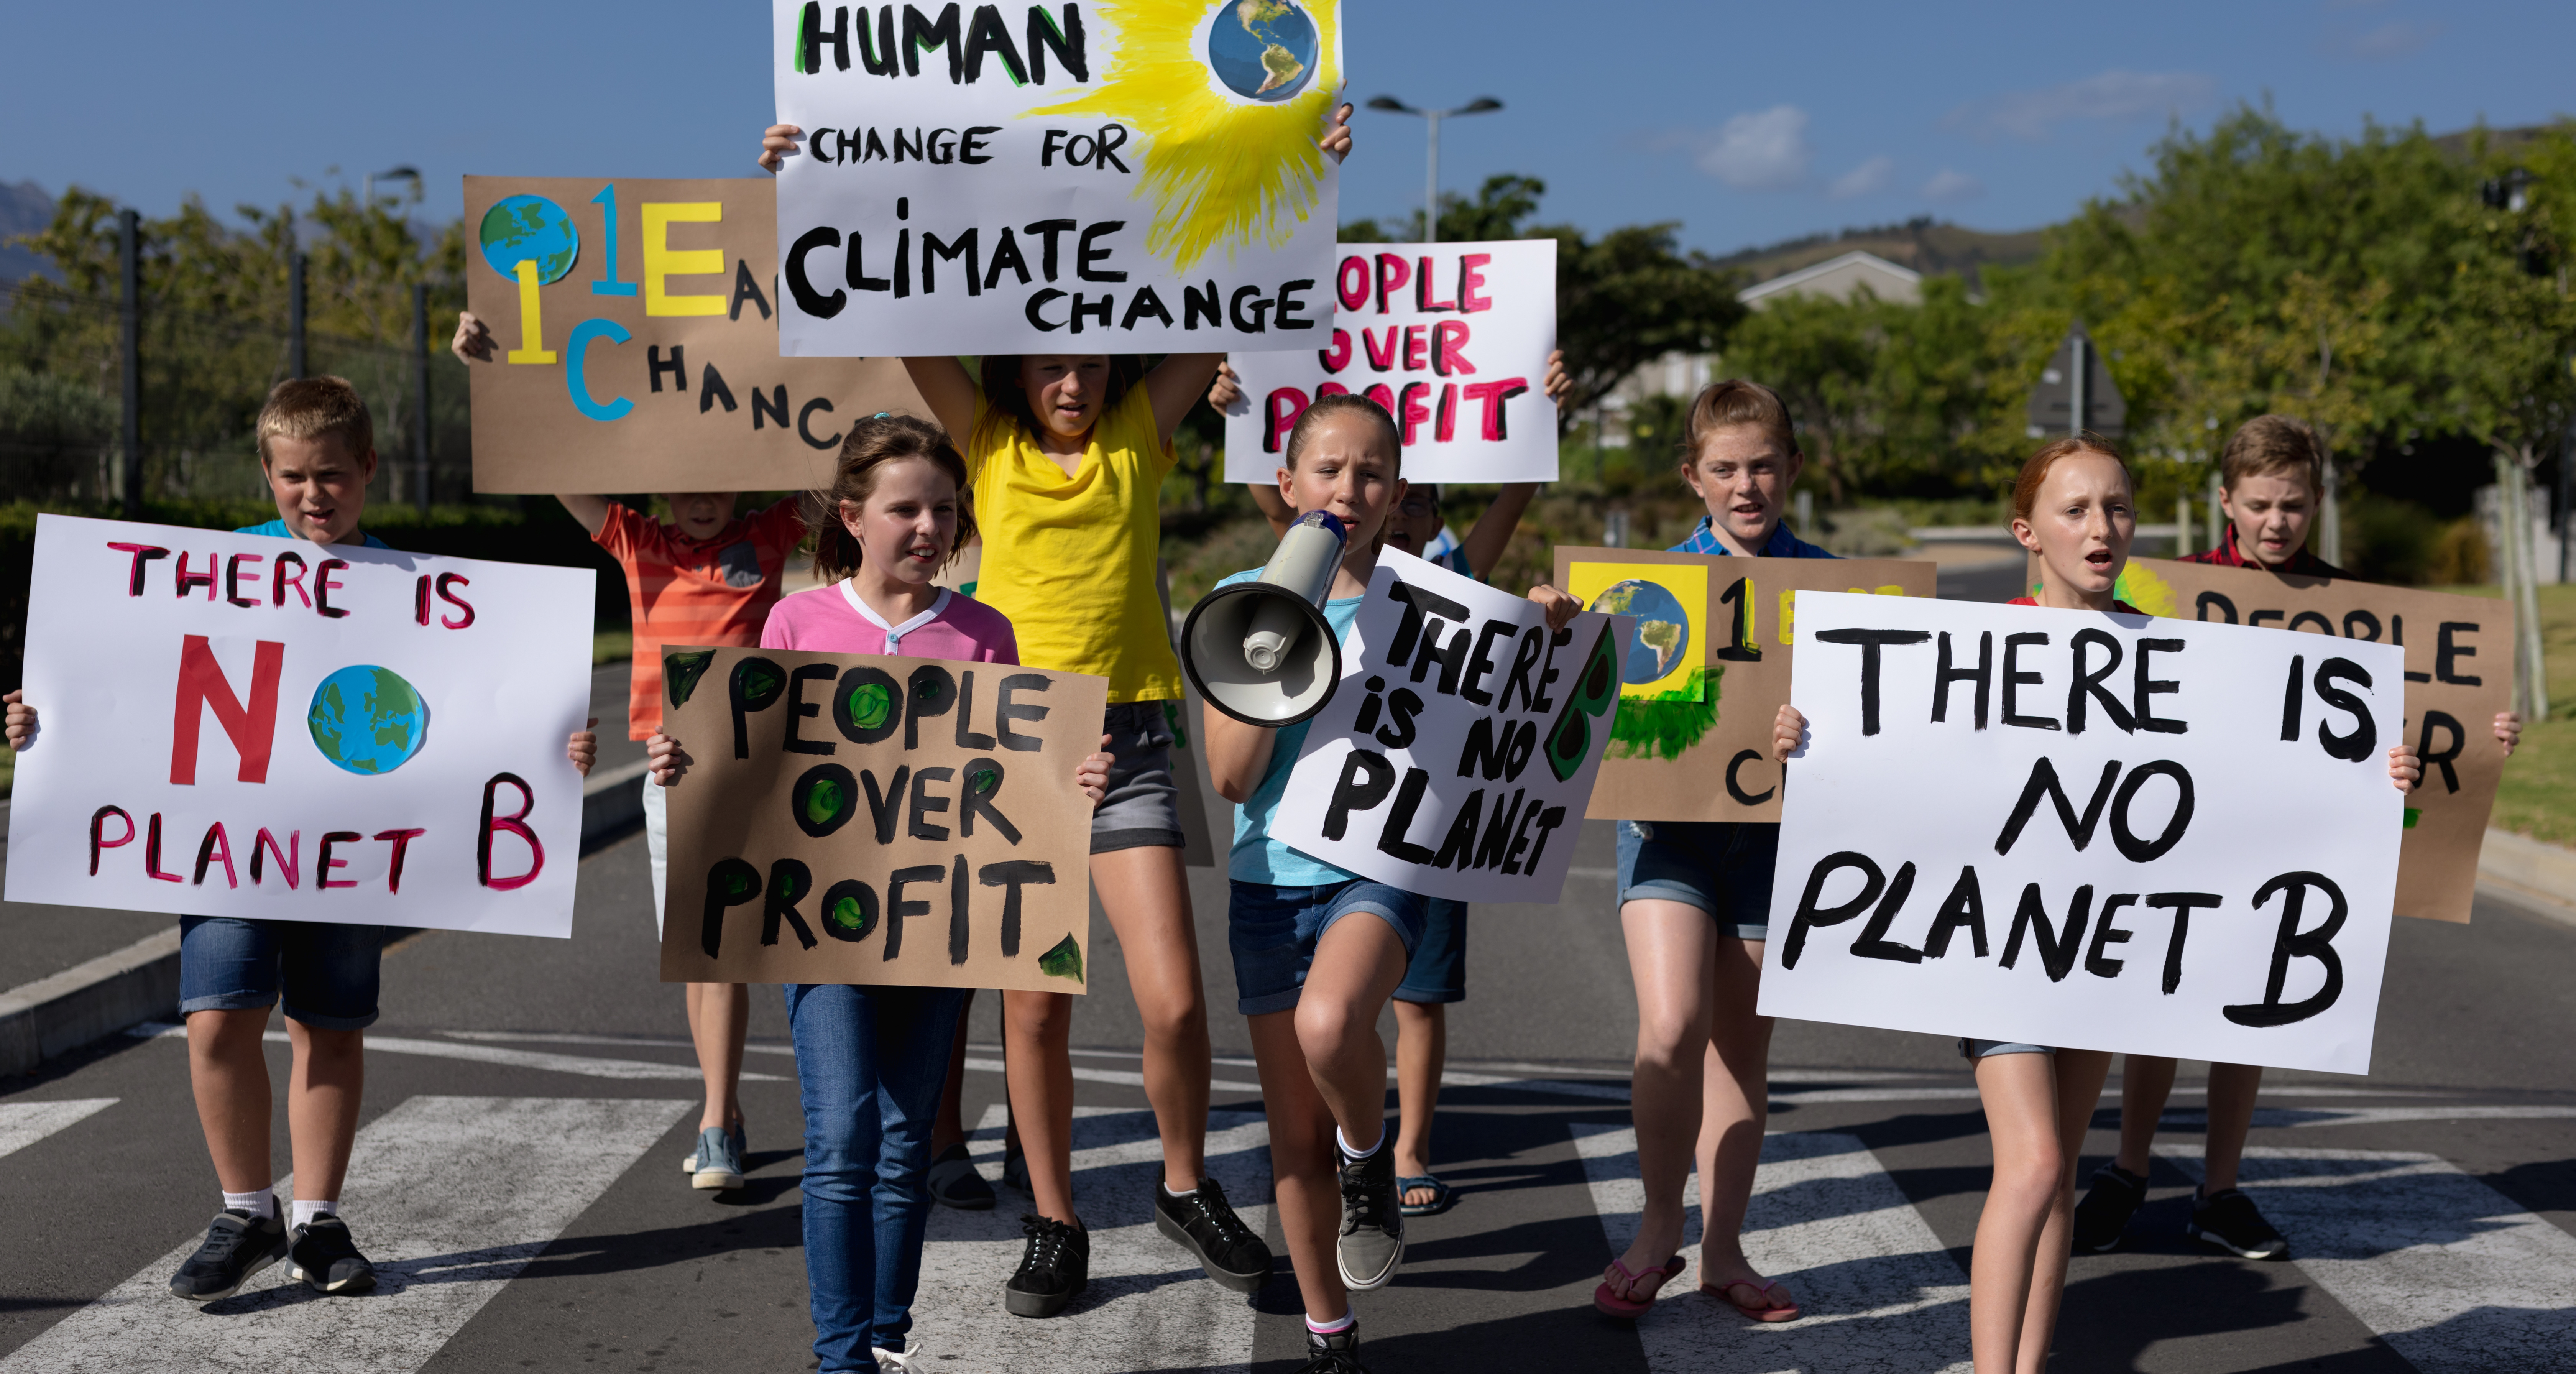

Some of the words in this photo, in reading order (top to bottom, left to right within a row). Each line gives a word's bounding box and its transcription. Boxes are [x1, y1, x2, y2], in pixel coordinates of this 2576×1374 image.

[794, 1, 1089, 88] HUMAN
[809, 125, 1003, 166] CHANGE
[1042, 123, 1131, 174] FOR
[591, 183, 637, 296] 1
[1334, 253, 1492, 314] OPLE
[1025, 279, 1315, 335] CHANGE
[1318, 320, 1476, 376] OVER
[566, 318, 876, 449] CHANC
[1263, 377, 1529, 454] PFIT
[107, 541, 351, 618] THERE
[415, 572, 475, 629] IS
[1717, 577, 1762, 662] 1
[1387, 579, 1572, 713] THERE
[729, 657, 1056, 760] PEOPLE
[1815, 627, 2188, 737] THERE
[2280, 653, 2377, 763] IS
[1457, 715, 1537, 783] NO
[89, 805, 426, 895] PLANET
[477, 772, 546, 892] B
[792, 758, 1022, 846] OVER
[1322, 749, 1566, 876] PLANET
[1995, 756, 2195, 863] NO
[702, 853, 1056, 968] PROFIT
[1782, 851, 2223, 996] PLANET
[2222, 871, 2348, 1028] B
